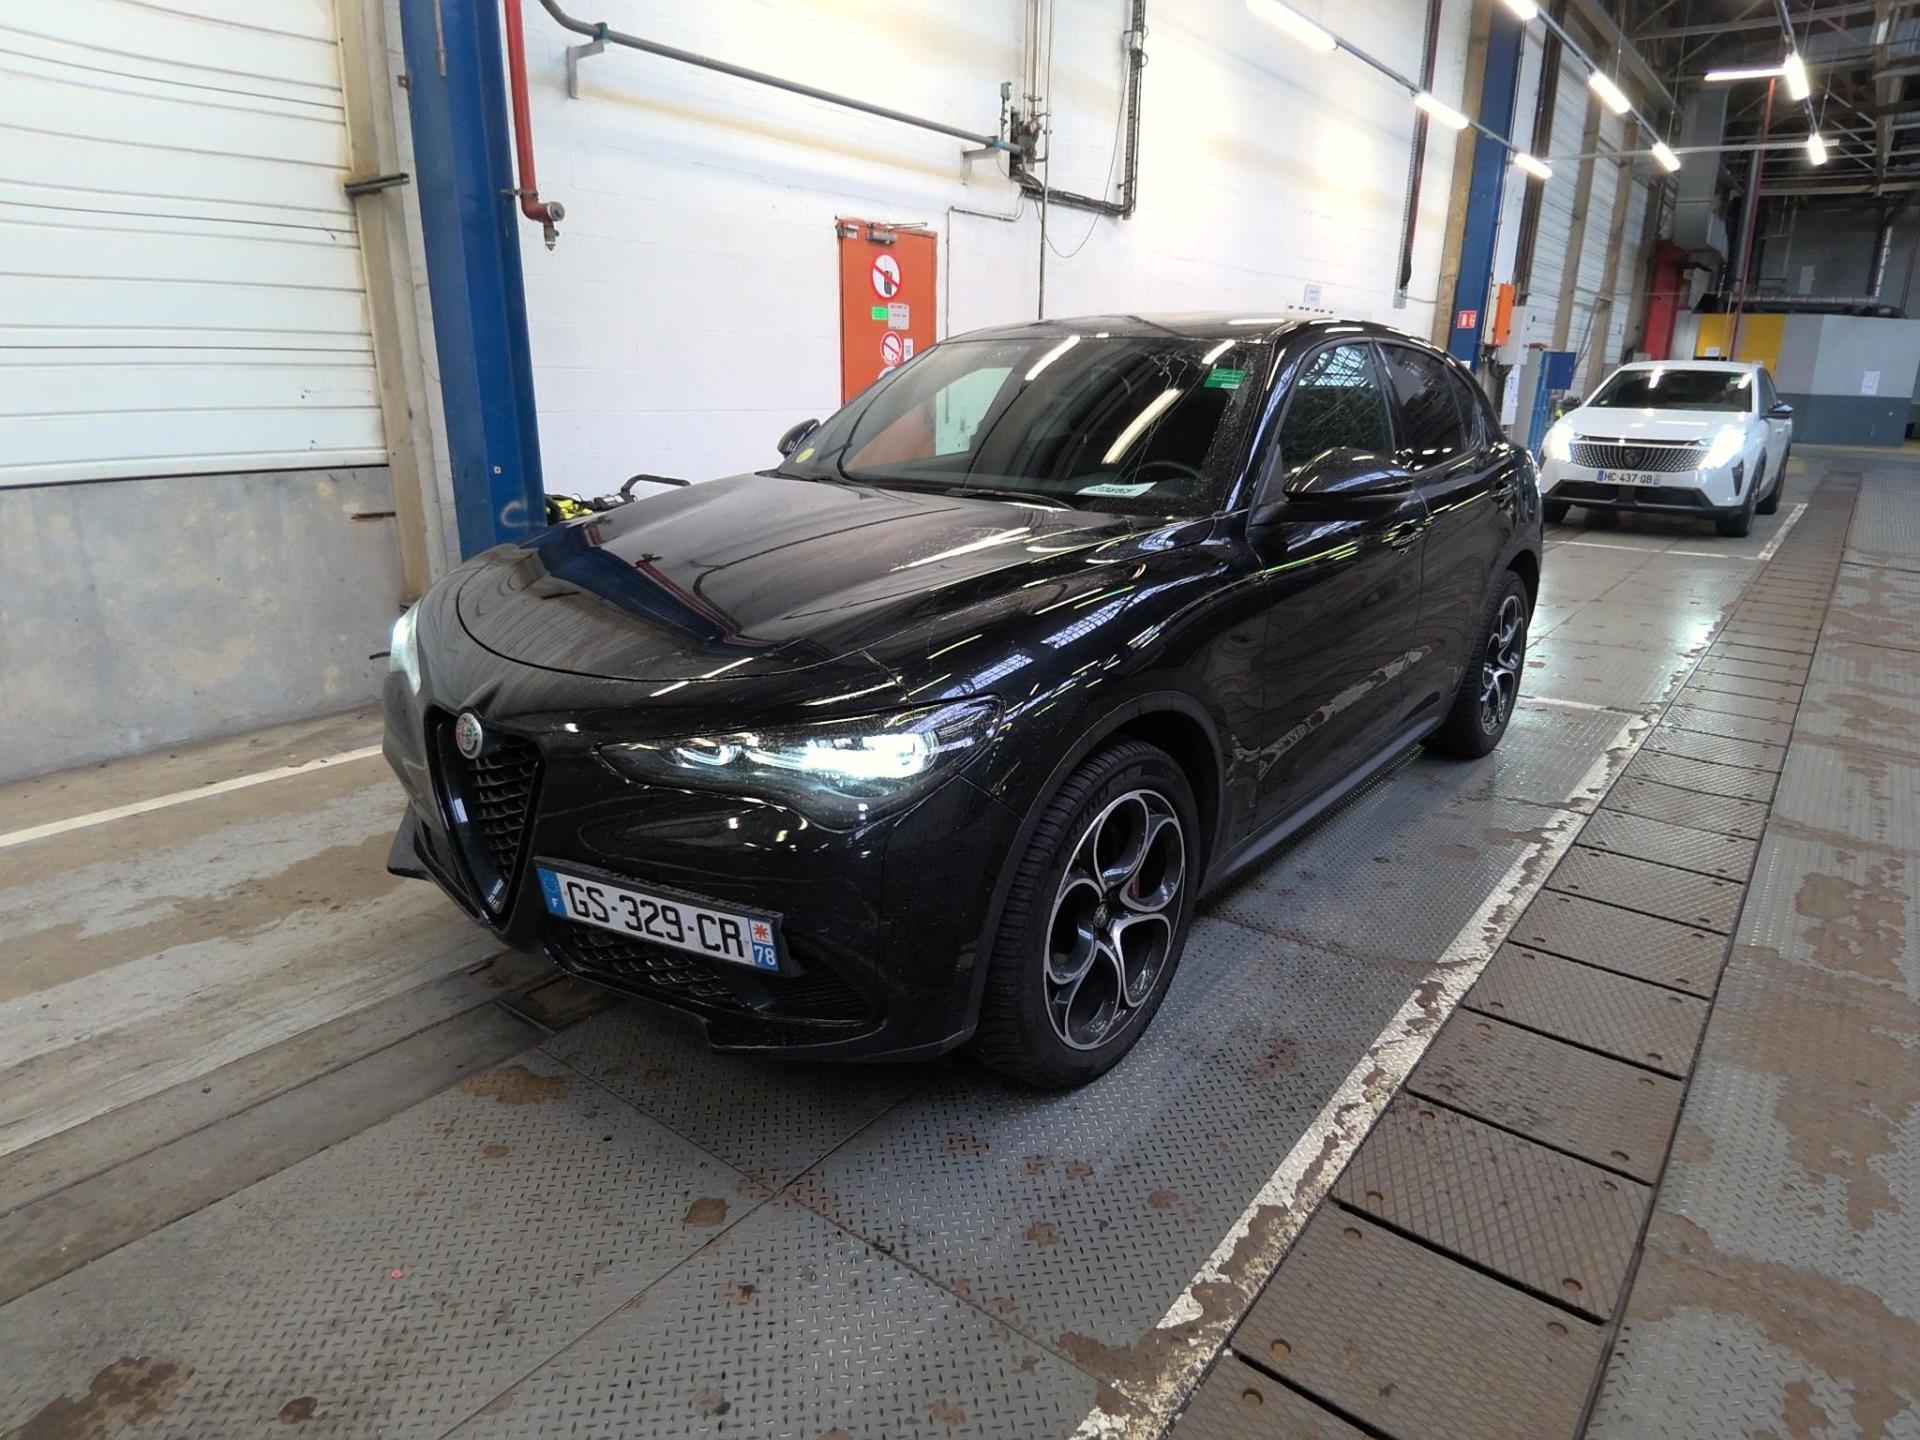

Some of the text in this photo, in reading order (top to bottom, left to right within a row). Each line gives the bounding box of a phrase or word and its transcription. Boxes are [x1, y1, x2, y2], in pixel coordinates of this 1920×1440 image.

[551, 897, 560, 908] F
[566, 881, 744, 957] GS-329-CR
[753, 944, 776, 966] 78
